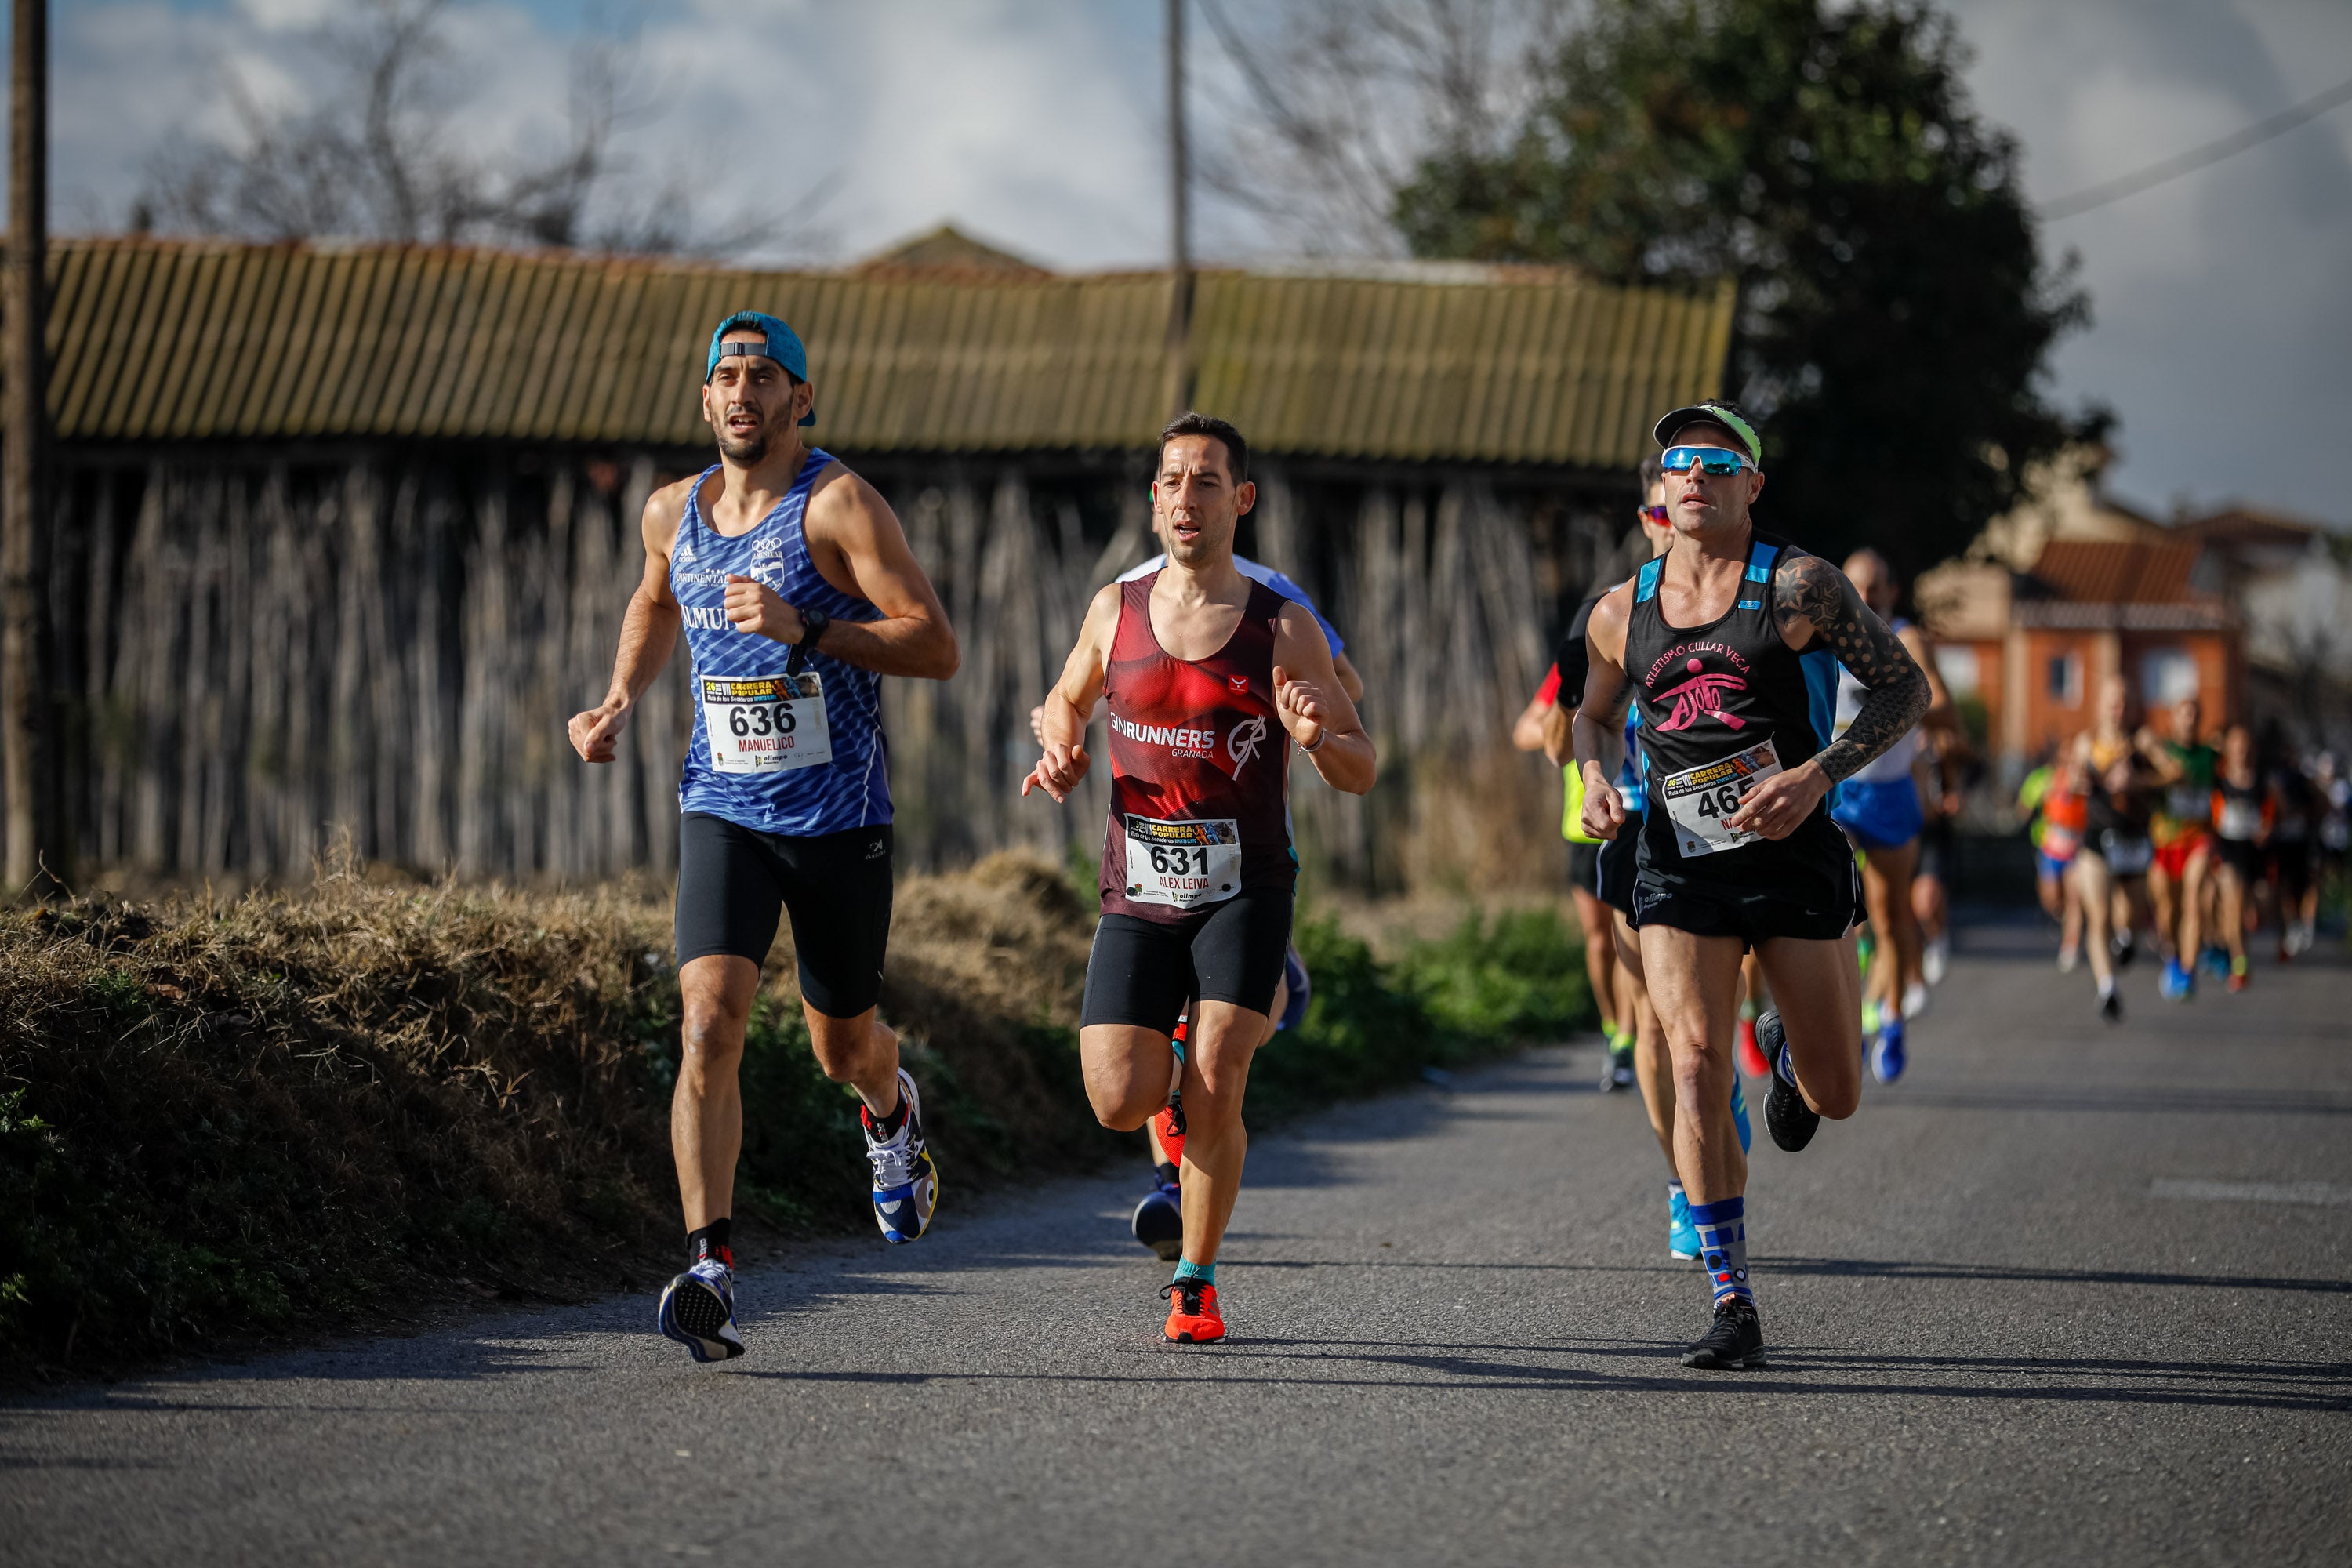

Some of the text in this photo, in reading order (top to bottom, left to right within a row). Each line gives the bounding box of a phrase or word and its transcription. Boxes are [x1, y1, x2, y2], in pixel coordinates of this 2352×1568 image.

[1645, 641, 1750, 688] ATLETISMO CULLAR VEGA
[706, 681, 716, 691] 26
[731, 681, 772, 690] CARRERA
[729, 702, 797, 737] 636
[1110, 711, 1215, 749] GINRUNNERS
[738, 735, 795, 753] MANUELICO
[1171, 747, 1214, 759] GRANADA
[1690, 763, 1732, 780] CARRERA
[1691, 768, 1733, 786] POPULAR
[1667, 778, 1676, 787] 26
[1693, 781, 1717, 791] Secaderos
[1152, 824, 1192, 833] CARRERA
[1150, 846, 1209, 876] 631
[1160, 876, 1209, 890] ALEX LEIVA
